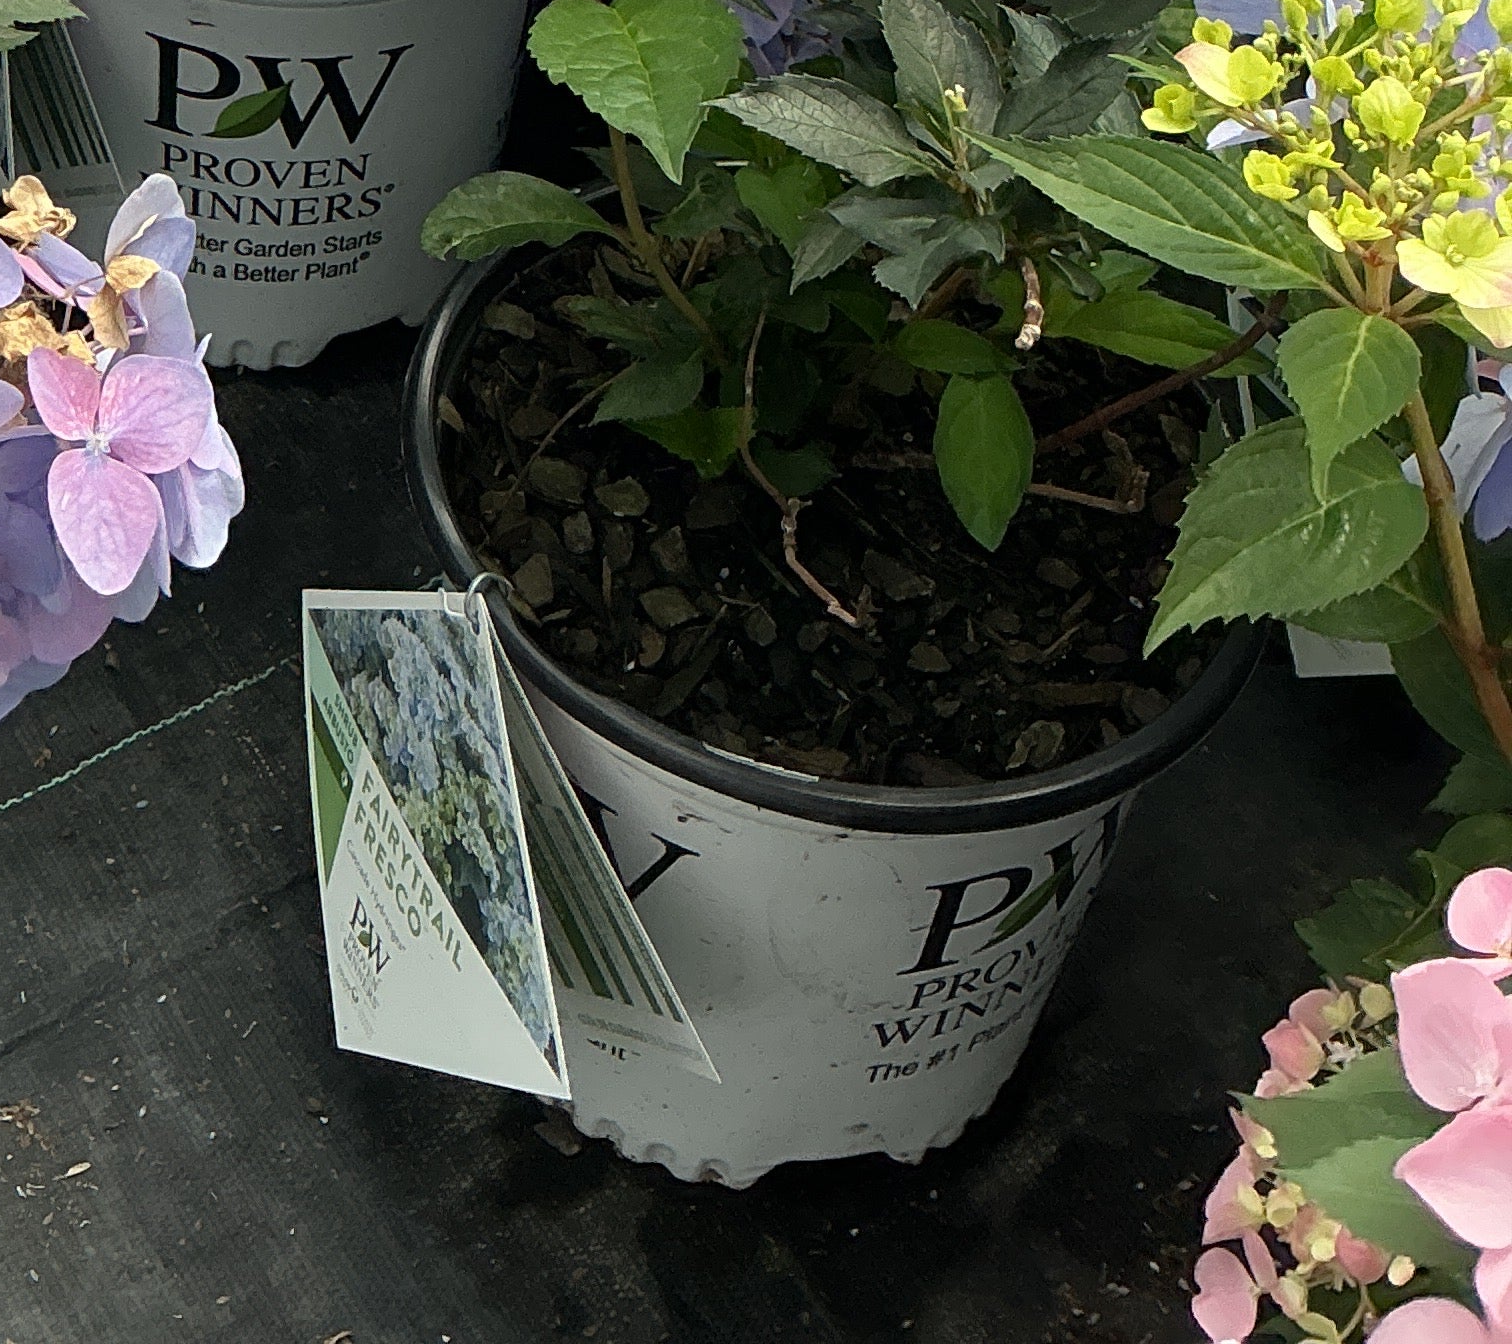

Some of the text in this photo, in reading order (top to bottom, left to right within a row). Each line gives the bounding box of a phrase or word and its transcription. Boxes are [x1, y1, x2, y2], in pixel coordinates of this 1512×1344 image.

[143, 30, 415, 151] PW
[159, 140, 373, 190] PROVEN
[213, 264, 227, 279] a
[233, 262, 300, 283] Better
[233, 236, 317, 258] Garden
[322, 228, 383, 254] Starts
[354, 799, 422, 937] FRESCO
[361, 769, 462, 972] FAIRYTRAIL
[348, 893, 392, 975] PW
[866, 1060, 920, 1084] The
